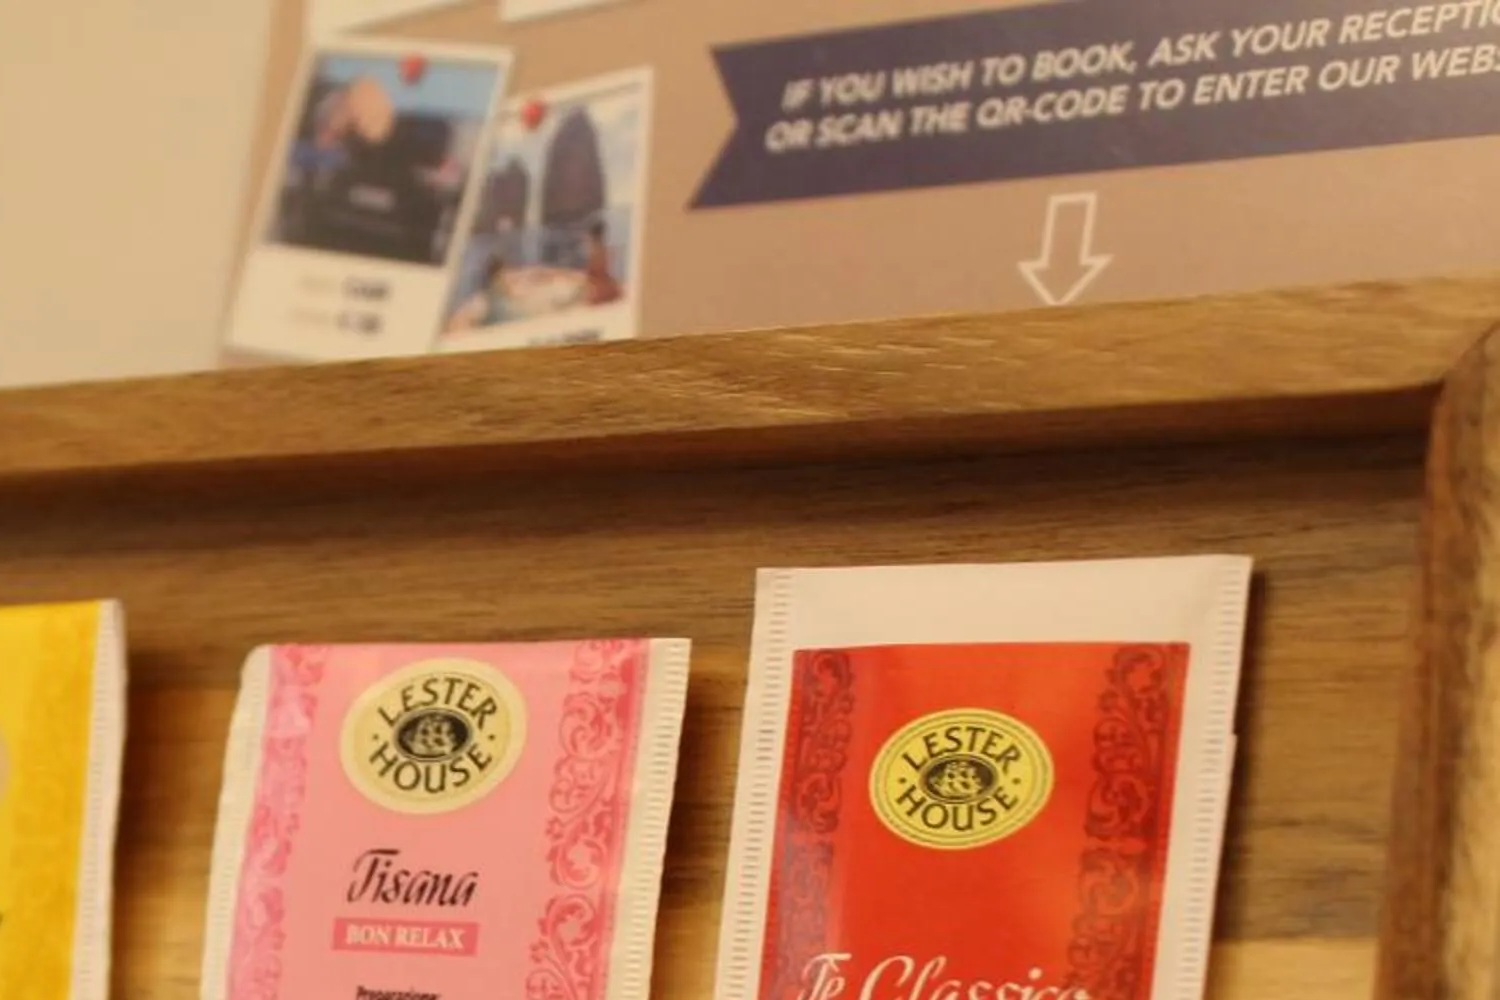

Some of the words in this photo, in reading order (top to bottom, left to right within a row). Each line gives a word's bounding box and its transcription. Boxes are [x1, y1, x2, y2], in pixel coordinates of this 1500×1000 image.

[782, 78, 813, 112] IF
[820, 71, 885, 106] YOU
[892, 60, 974, 96] WISH
[981, 55, 1026, 86] TO
[1032, 41, 1137, 81] BOOK,
[1148, 31, 1219, 67] ASK
[1230, 18, 1331, 58] YOUR
[764, 119, 813, 152] OR
[815, 109, 903, 148] SCAN
[909, 101, 972, 135] THE
[976, 84, 1130, 128] QR-CODE
[1139, 78, 1185, 111] TO
[1193, 65, 1309, 106] ENTER
[1318, 54, 1400, 91] OUR
[378, 677, 497, 729] LESTER
[369, 742, 492, 793] HOUSE
[901, 726, 1022, 775] LESTER
[896, 785, 1018, 831] HOUSE
[347, 848, 479, 907] Tisana
[346, 923, 390, 948] BON
[395, 926, 465, 950] RELAX
